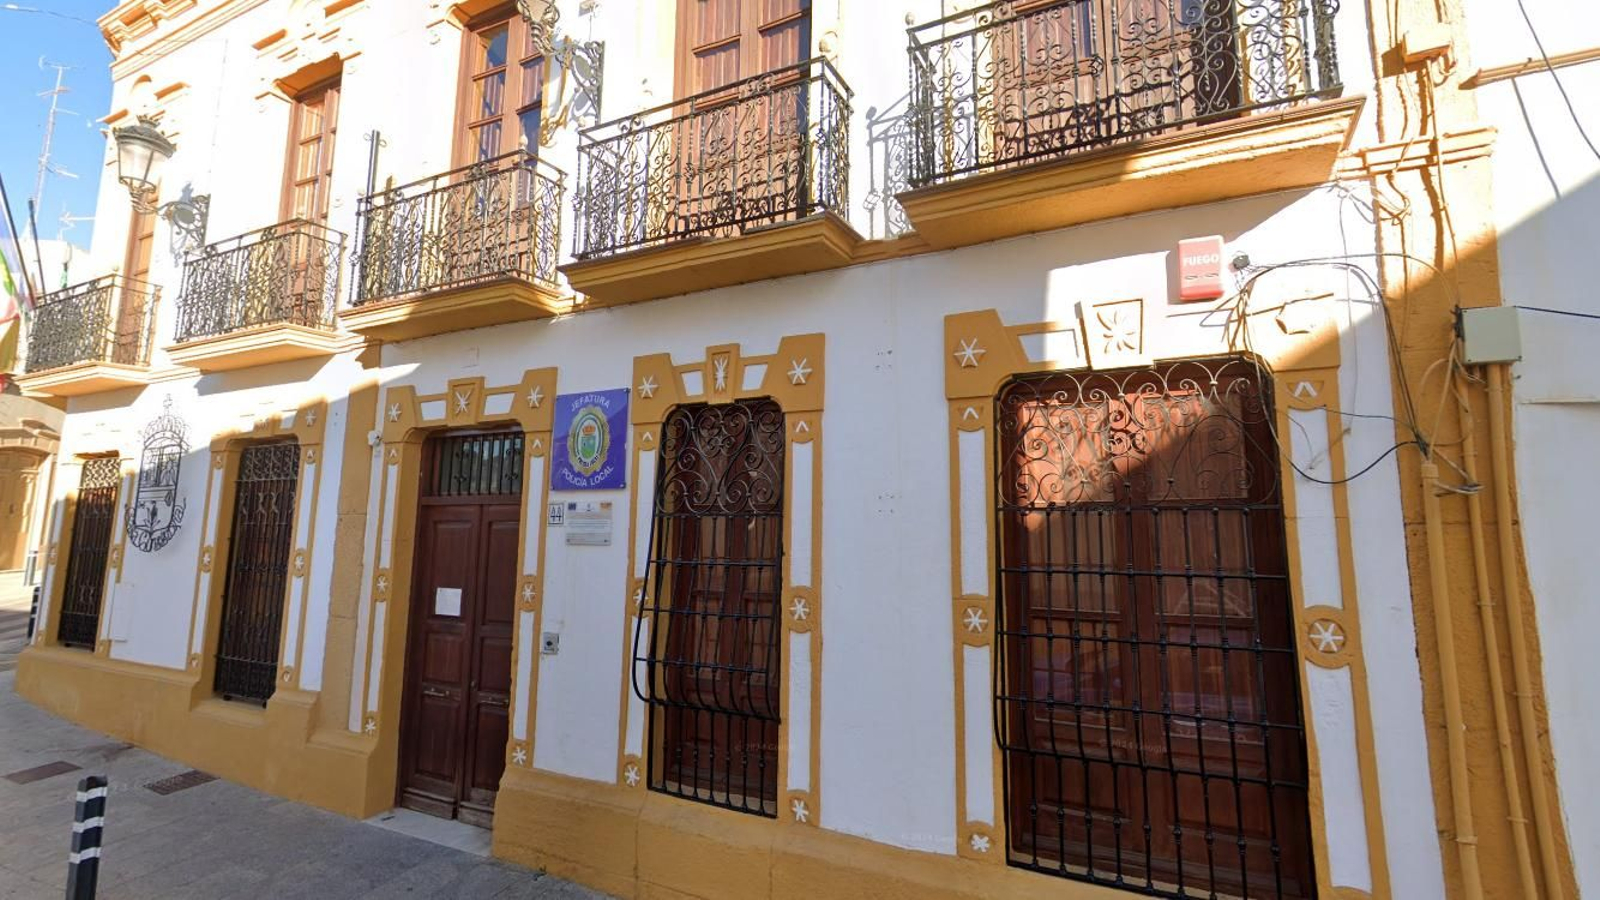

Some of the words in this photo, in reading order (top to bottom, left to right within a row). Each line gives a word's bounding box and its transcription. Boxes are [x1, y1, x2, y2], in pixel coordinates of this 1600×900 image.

[1182, 253, 1219, 267] FUEGO
[571, 394, 610, 412] JEFATURA
[590, 466, 614, 486] LOCAL
[550, 506, 562, 522] 44
